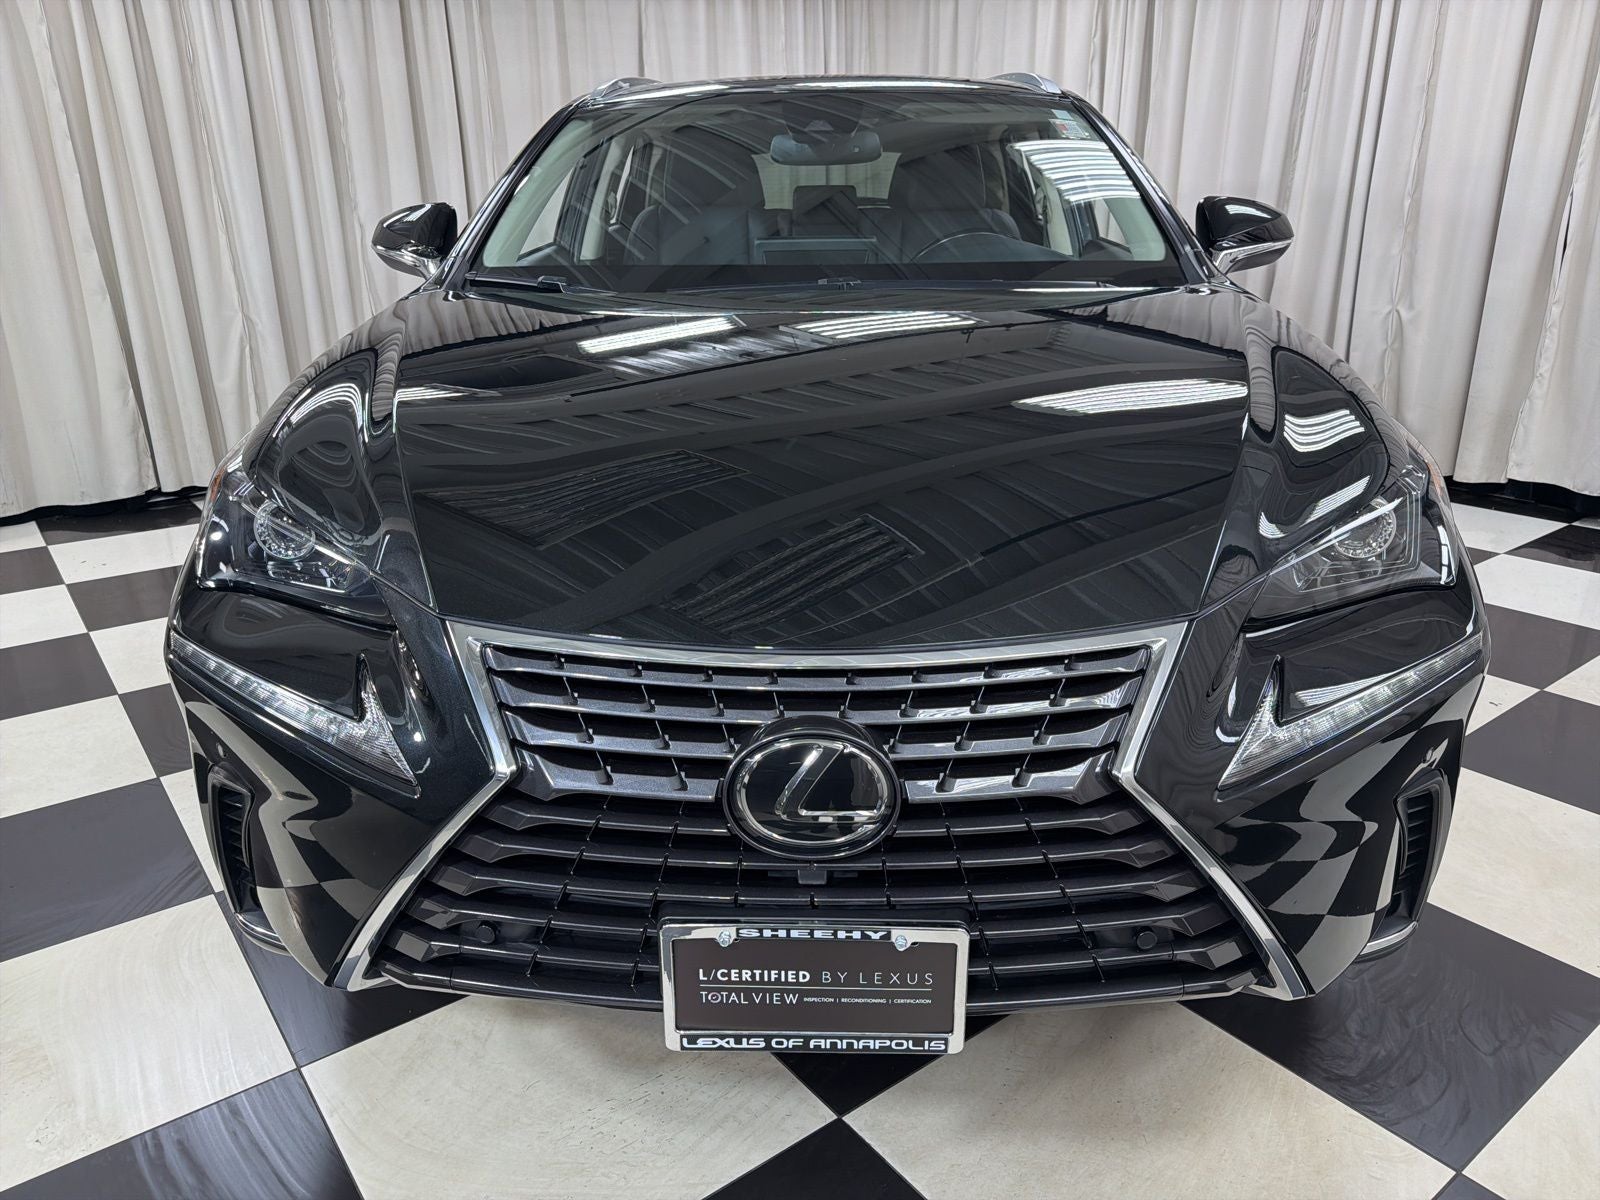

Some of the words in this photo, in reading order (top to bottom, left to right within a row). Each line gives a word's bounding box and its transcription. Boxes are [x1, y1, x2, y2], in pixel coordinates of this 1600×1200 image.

[738, 928, 888, 940] SHEEHY
[699, 968, 811, 983] L/CERTIFIED
[822, 971, 848, 984] BY
[859, 972, 934, 985] LEXUS
[682, 1037, 766, 1049] LEXUS
[771, 1038, 804, 1049] OF
[809, 1038, 946, 1051] ANNAPOLIS
